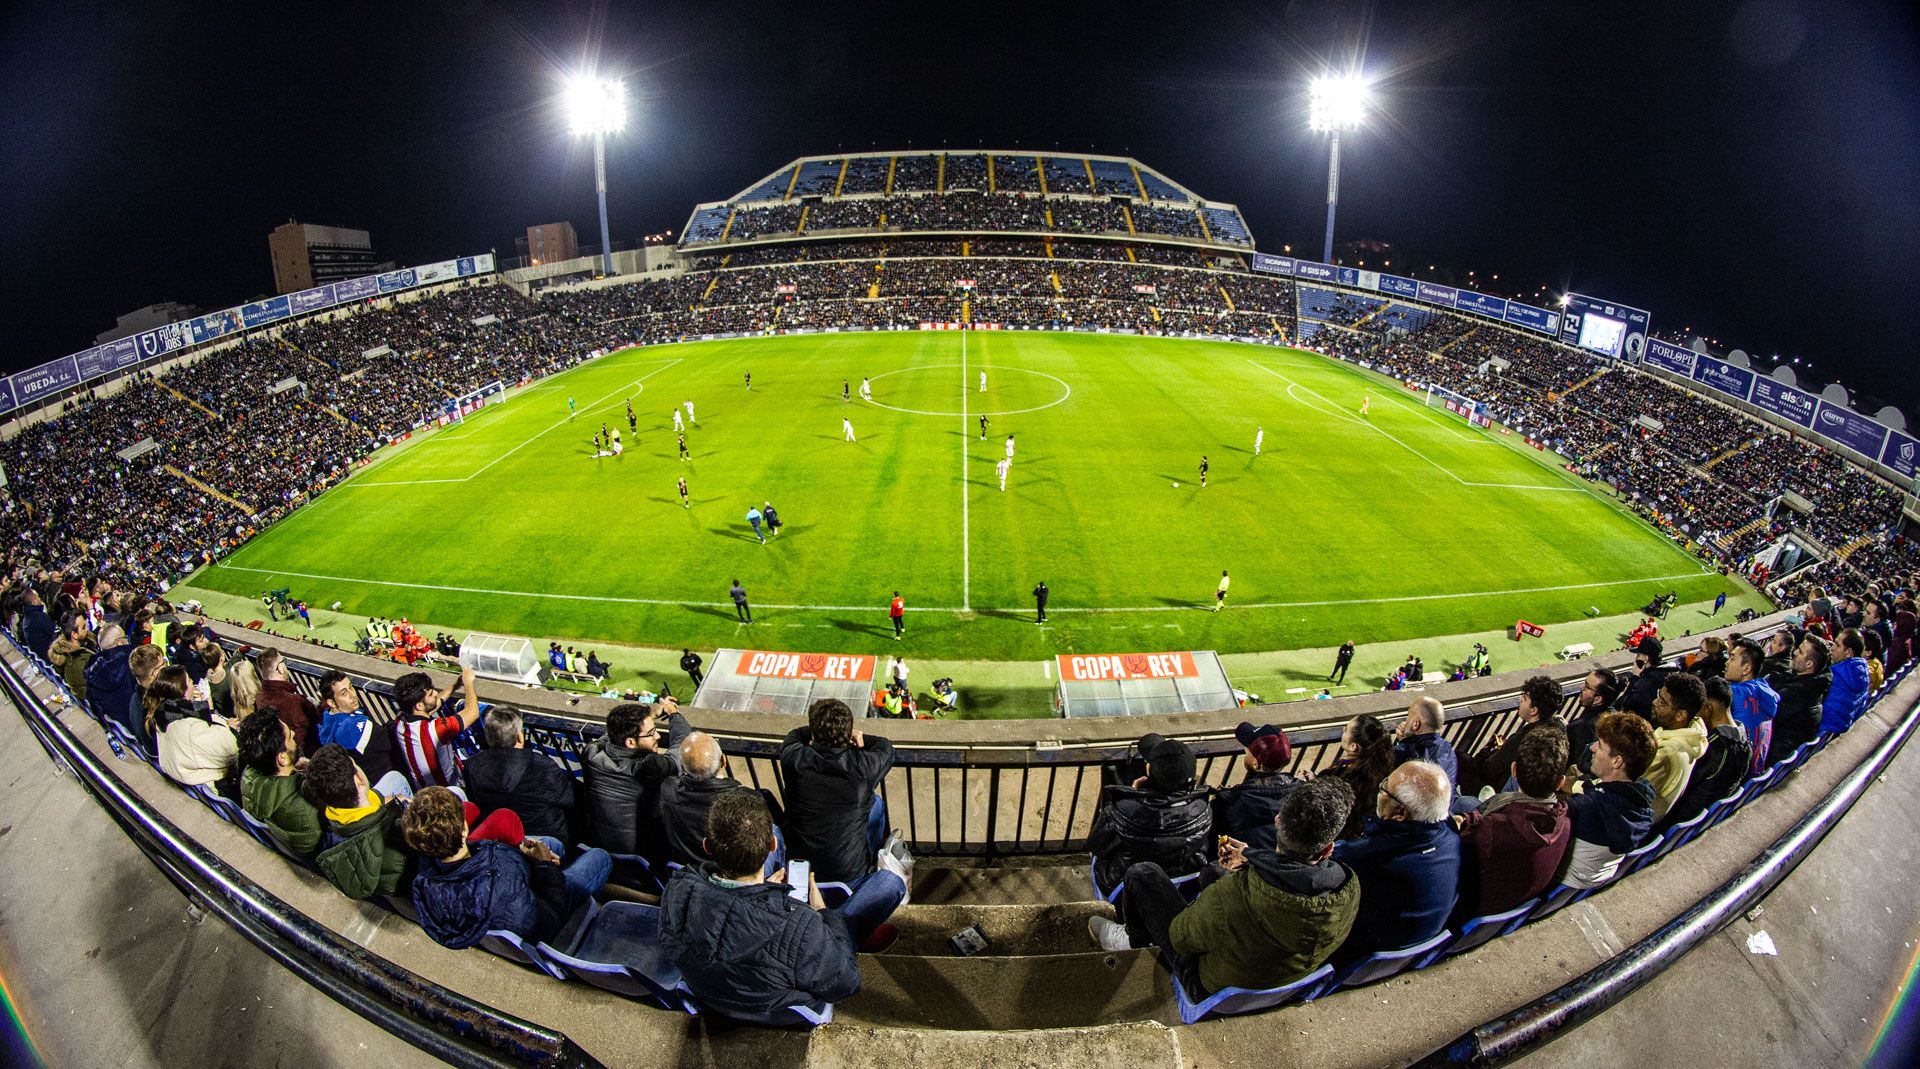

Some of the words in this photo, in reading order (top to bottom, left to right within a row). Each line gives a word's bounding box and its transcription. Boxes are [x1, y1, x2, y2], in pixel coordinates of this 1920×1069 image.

[1265, 258, 1291, 267] SCANIA
[165, 336, 182, 351] JOBS
[1781, 391, 1812, 410] alson
[1824, 411, 1845, 424] auren
[748, 653, 801, 677] COPA
[823, 656, 863, 679] REY
[1072, 655, 1126, 679] COPA
[1147, 654, 1184, 677] REY
